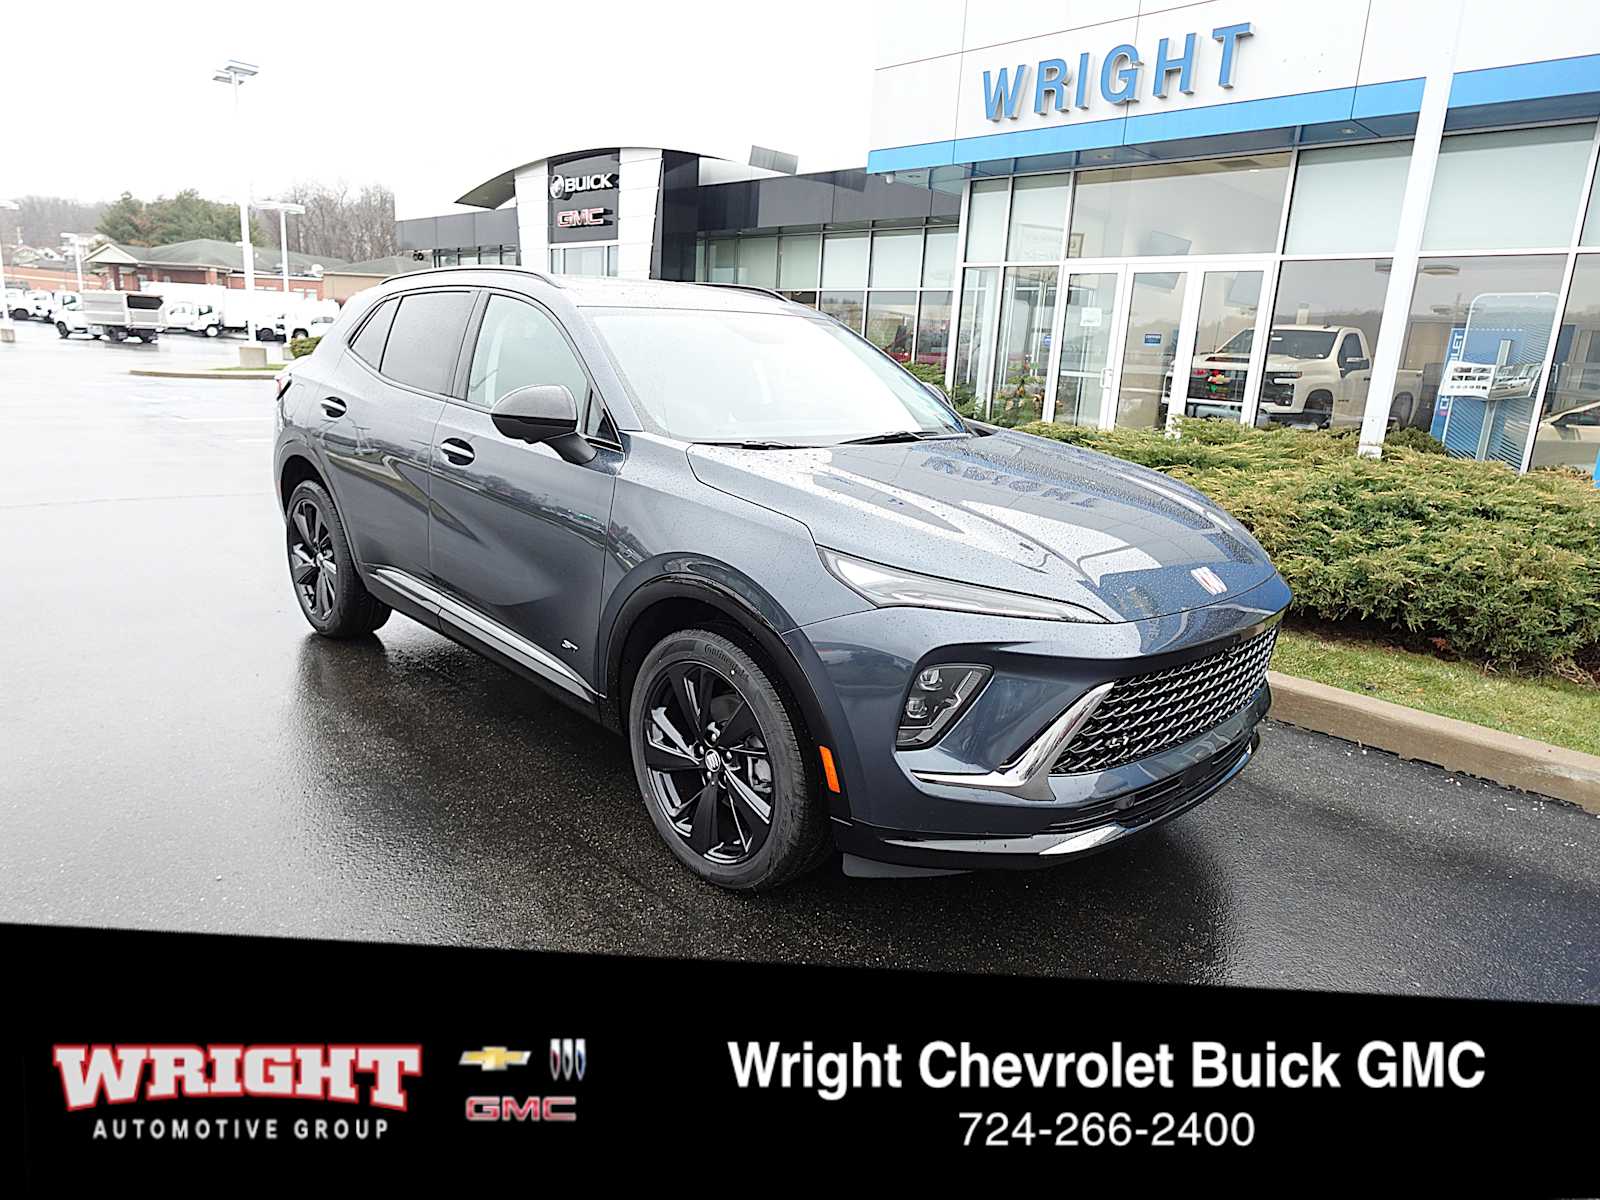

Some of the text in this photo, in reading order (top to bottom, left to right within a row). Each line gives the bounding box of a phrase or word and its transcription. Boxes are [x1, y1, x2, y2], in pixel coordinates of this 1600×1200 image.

[982, 22, 1255, 121] WRIGHT
[564, 173, 613, 193] BUICK
[557, 207, 604, 227] GMC
